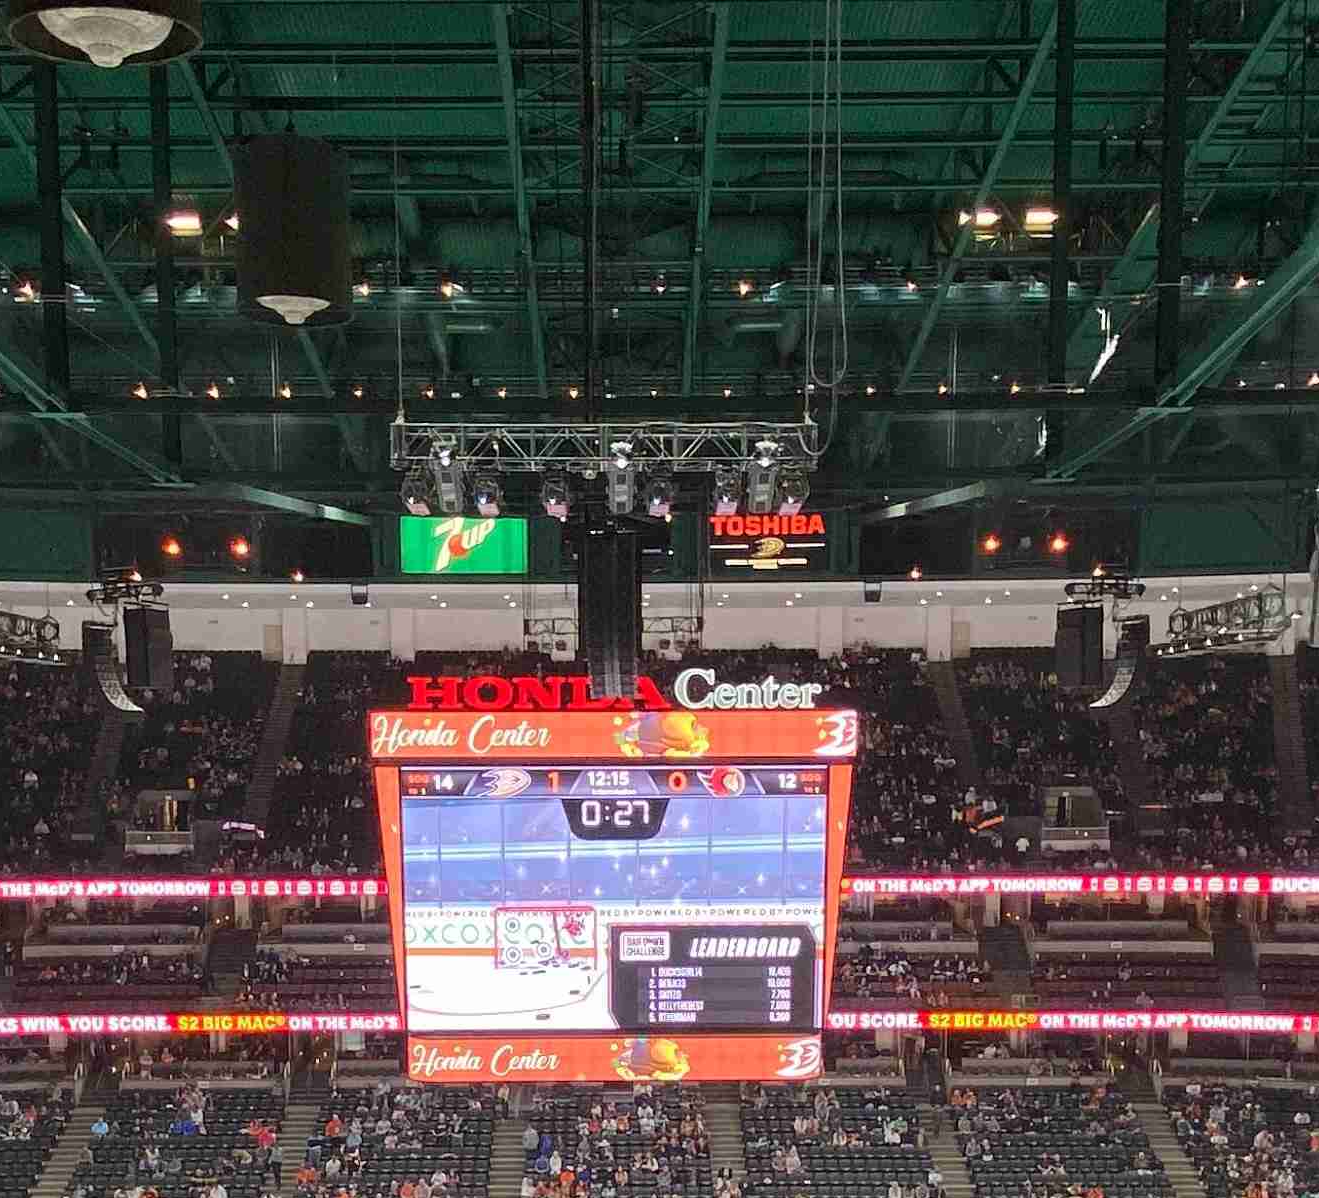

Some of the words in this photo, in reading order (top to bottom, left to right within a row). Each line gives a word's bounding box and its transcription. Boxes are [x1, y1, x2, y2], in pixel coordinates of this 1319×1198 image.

[709, 514, 826, 537] TOSHIBA
[673, 667, 823, 710] Center
[371, 715, 459, 754] Honda
[467, 714, 552, 754] Center
[433, 775, 455, 790] 14
[587, 771, 630, 786] 12:15
[777, 774, 798, 789] 12
[581, 800, 650, 827] 0:27
[1, 881, 31, 896] THE
[86, 880, 118, 896] APP
[120, 880, 210, 896] TOMORROW
[852, 879, 876, 892] ON
[878, 879, 909, 892] THE
[961, 879, 989, 892] APP
[992, 878, 1083, 893] TOMORROW
[689, 937, 803, 958] LEADERBOARD
[68, 1016, 102, 1032] YOU
[202, 1015, 234, 1031] BIG
[288, 1016, 312, 1030] ON
[316, 1016, 348, 1030] THE
[953, 1014, 985, 1028] BIG
[1039, 1014, 1062, 1028] ON
[1067, 1014, 1100, 1029] THE
[1155, 1015, 1189, 1030] APP
[1191, 1015, 1294, 1031] TOMORROW
[411, 1045, 483, 1077] Honda
[490, 1044, 561, 1077] Center
